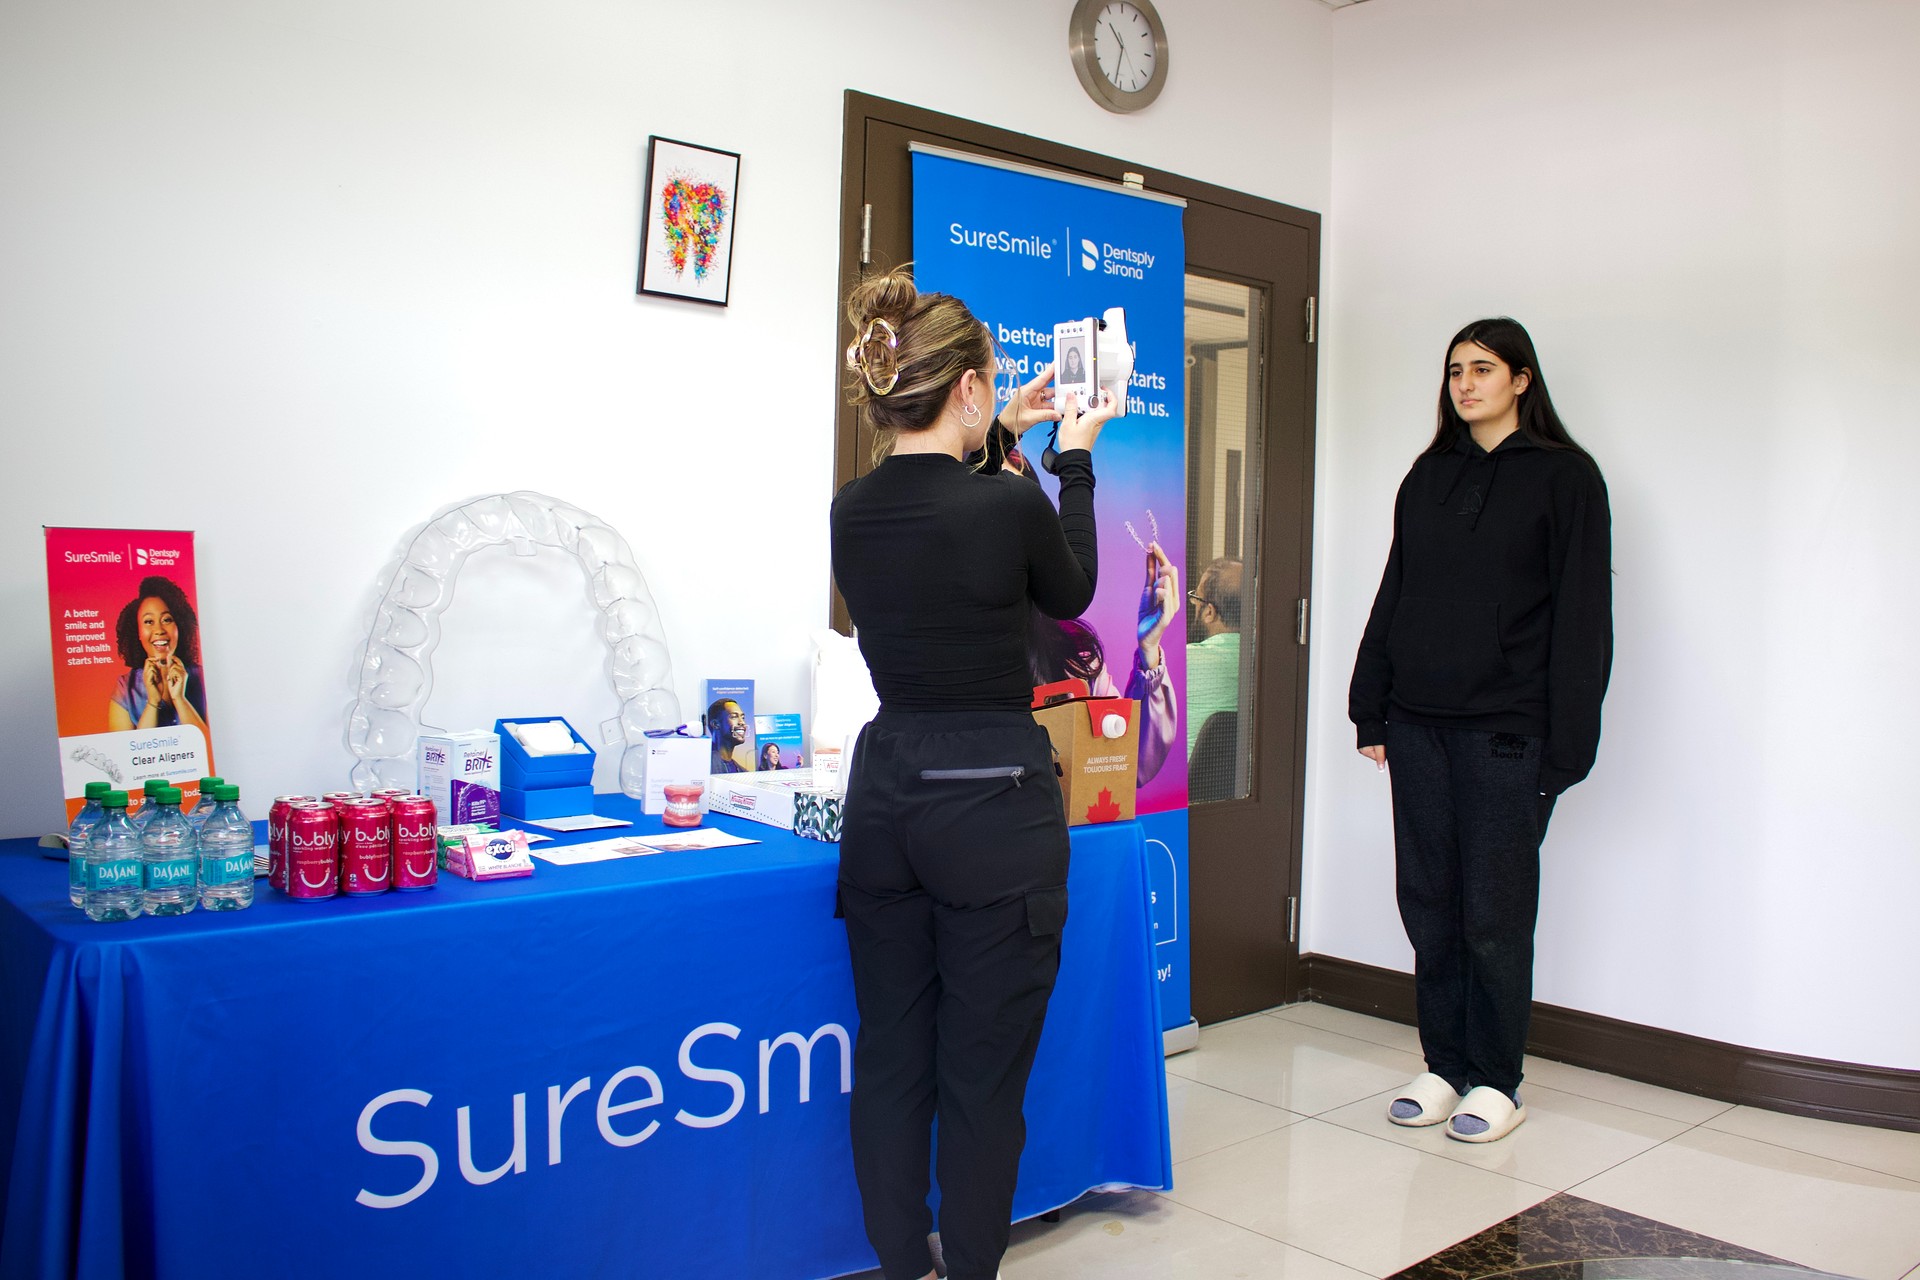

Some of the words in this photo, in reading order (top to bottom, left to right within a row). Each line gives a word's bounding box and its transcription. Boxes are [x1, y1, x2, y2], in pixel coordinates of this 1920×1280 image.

[950, 223, 1052, 259] SureSmile
[1103, 243, 1155, 268] Dentsply
[1103, 260, 1144, 280] Sirona
[998, 323, 1053, 348] better
[1127, 395, 1146, 415] ith
[1149, 402, 1170, 418] us.
[64, 551, 122, 563] SureSmile
[149, 548, 180, 558] Dentsply
[150, 558, 174, 566] Sirona
[64, 610, 71, 618] A
[73, 610, 99, 618] better
[64, 621, 87, 630] smile
[89, 621, 105, 629] and
[65, 633, 106, 643] improved
[66, 645, 84, 654] oral
[86, 644, 111, 652] health
[67, 656, 92, 666] starts
[94, 655, 114, 664] here.
[129, 736, 179, 751] SureSmile
[132, 757, 156, 766] Clear
[158, 751, 195, 763] Aligners
[465, 754, 493, 773] BRITE
[1087, 756, 1109, 765] ALWAYS
[184, 789, 202, 798] toda
[485, 840, 516, 857] excel
[99, 864, 139, 882] DASANI
[153, 864, 192, 882] DASANI
[225, 857, 254, 874] DASAN
[355, 1022, 852, 1210] SureSm
